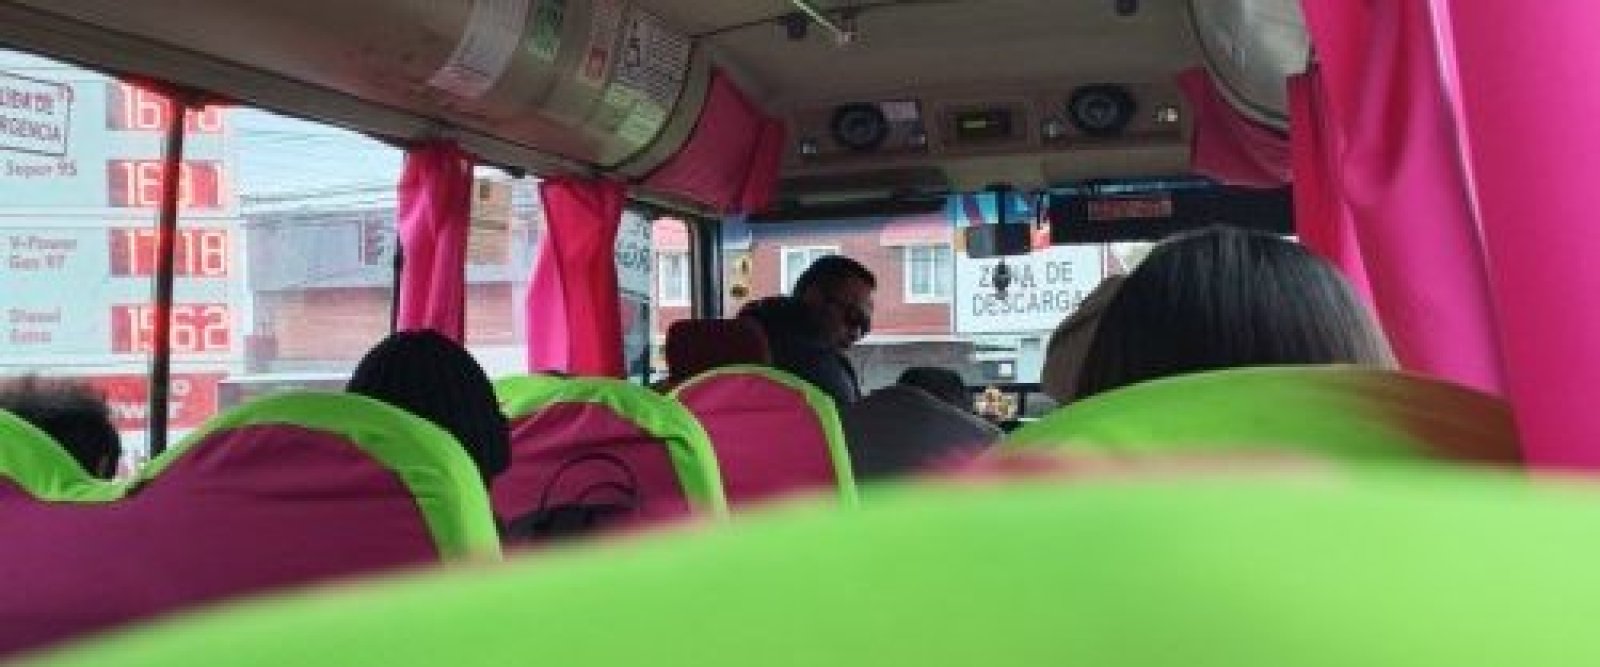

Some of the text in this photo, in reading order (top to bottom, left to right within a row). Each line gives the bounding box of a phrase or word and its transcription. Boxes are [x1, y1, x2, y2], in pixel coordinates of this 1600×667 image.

[978, 261, 1073, 288] ZNA DE
[127, 305, 231, 351] 1562
